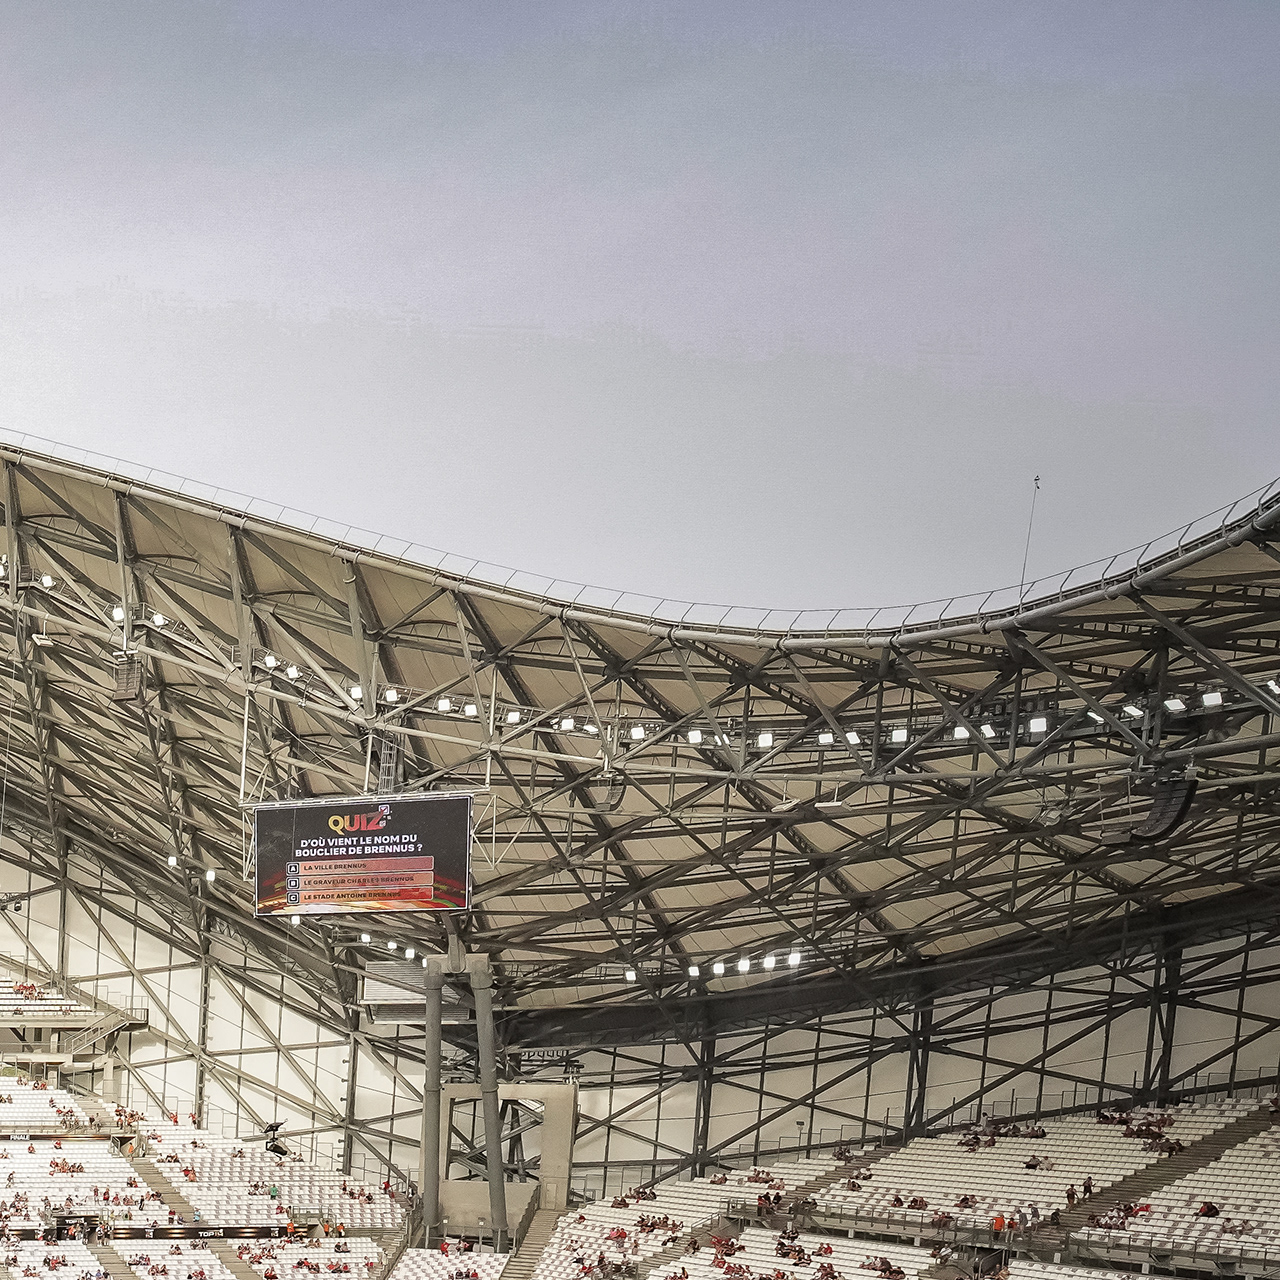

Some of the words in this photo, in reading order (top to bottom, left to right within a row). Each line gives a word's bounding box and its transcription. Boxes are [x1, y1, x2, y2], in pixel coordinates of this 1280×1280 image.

[328, 812, 385, 836] QUIZ
[327, 836, 358, 846] VIENT
[360, 835, 373, 845] LE
[374, 834, 400, 844] NOM
[402, 833, 417, 843] DU
[295, 846, 346, 857] BOUCLIER
[348, 846, 362, 855] DE
[364, 844, 414, 855] BRENNUS
